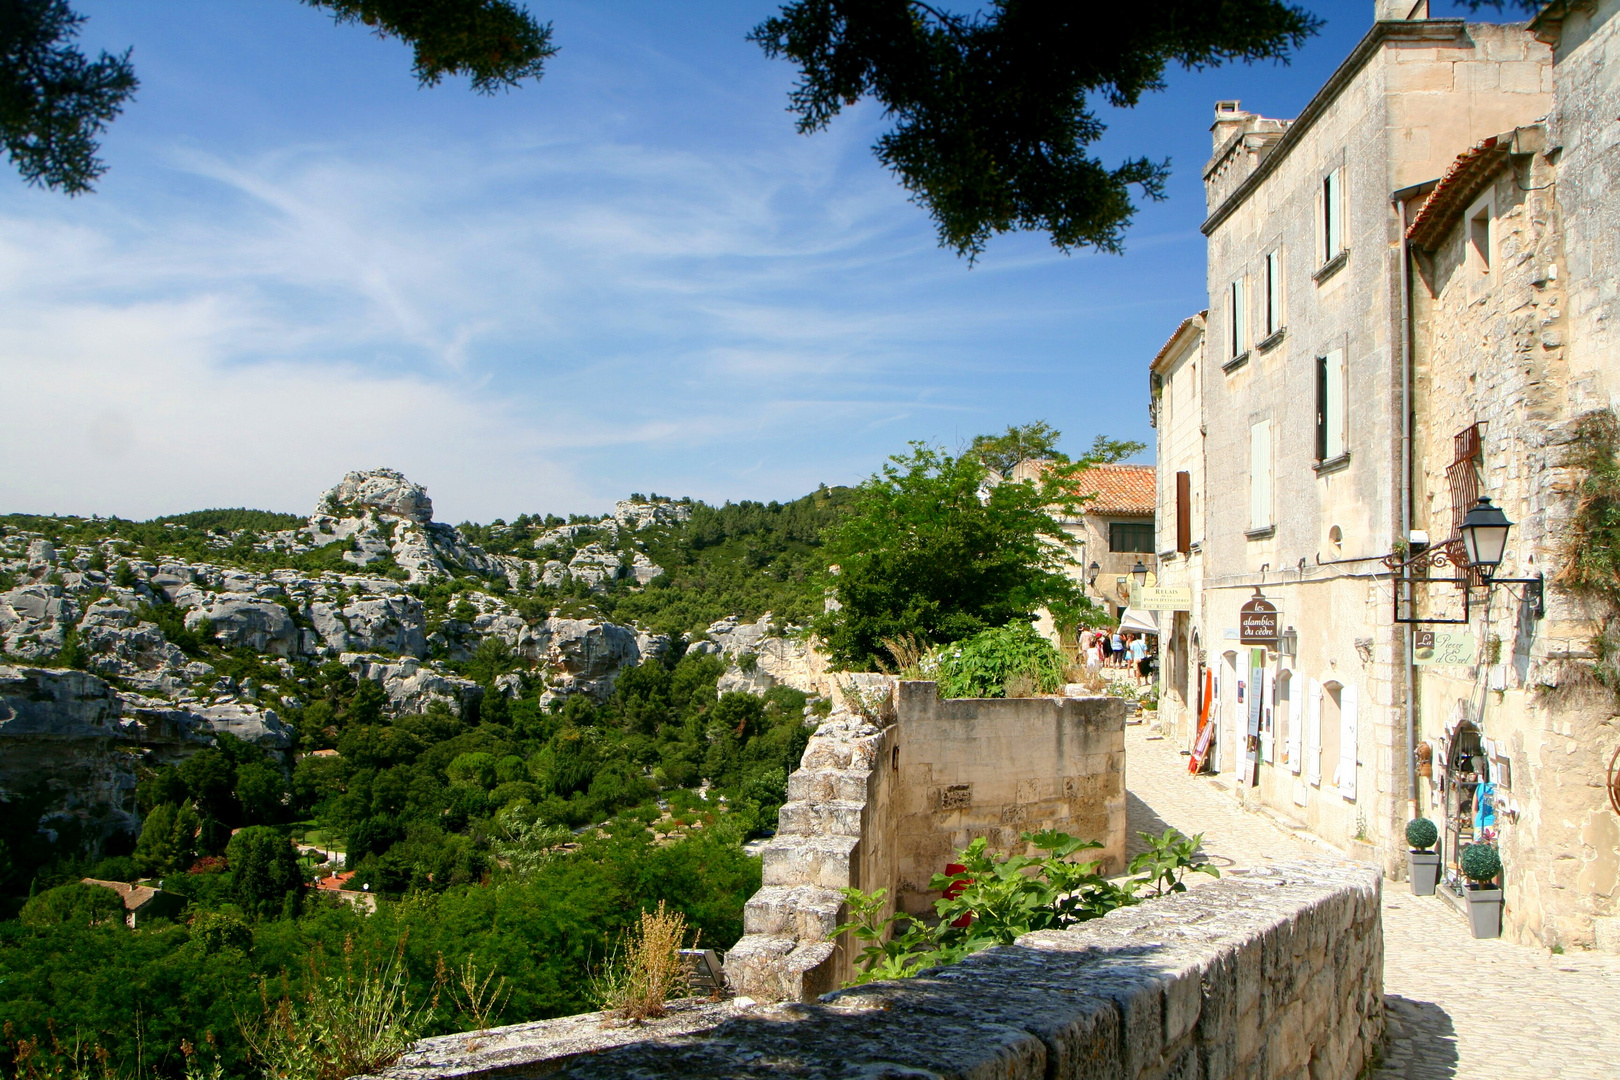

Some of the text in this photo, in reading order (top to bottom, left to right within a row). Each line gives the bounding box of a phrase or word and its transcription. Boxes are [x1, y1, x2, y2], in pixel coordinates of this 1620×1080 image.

[1254, 602, 1264, 611] les
[1243, 614, 1274, 626] alambics
[1244, 626, 1254, 635] du
[1255, 626, 1274, 635] cèdre
[1417, 633, 1463, 648] La Pierre
